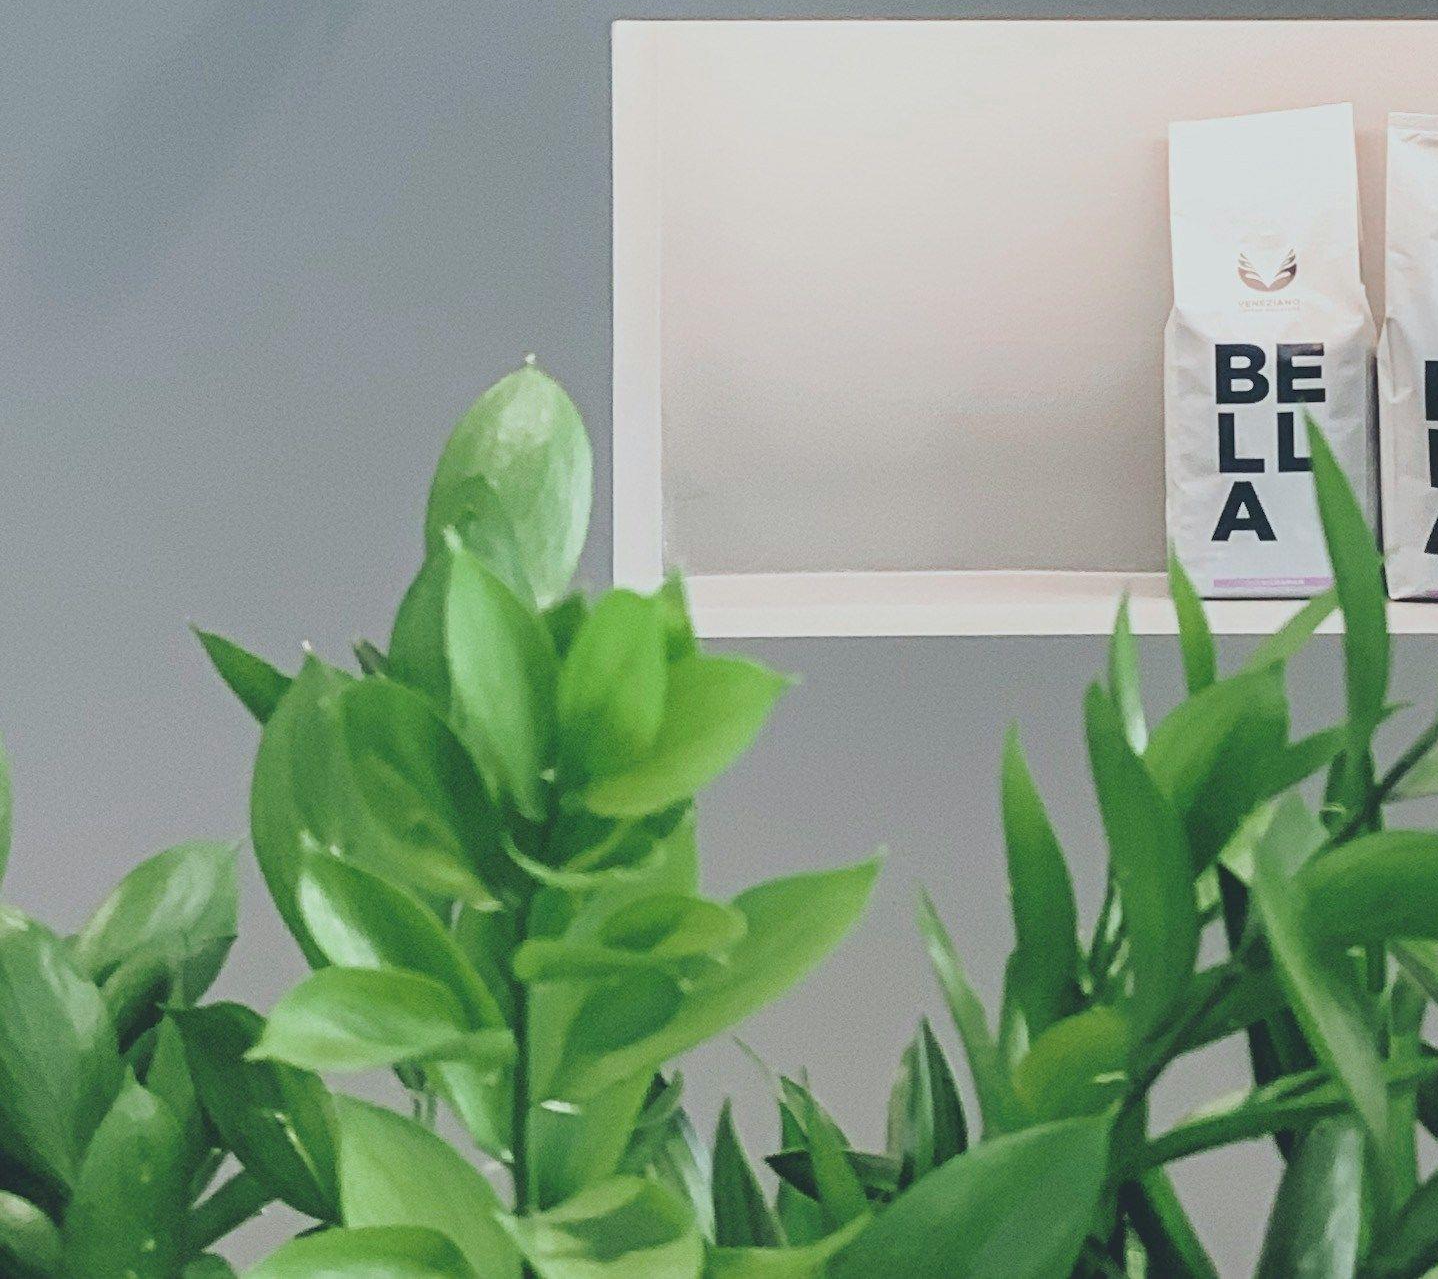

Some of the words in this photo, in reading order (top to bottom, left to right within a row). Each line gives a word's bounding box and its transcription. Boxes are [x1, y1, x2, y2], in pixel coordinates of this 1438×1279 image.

[1215, 343, 1326, 404] BE
[1218, 412, 1314, 473] LL
[1211, 481, 1278, 542] A
